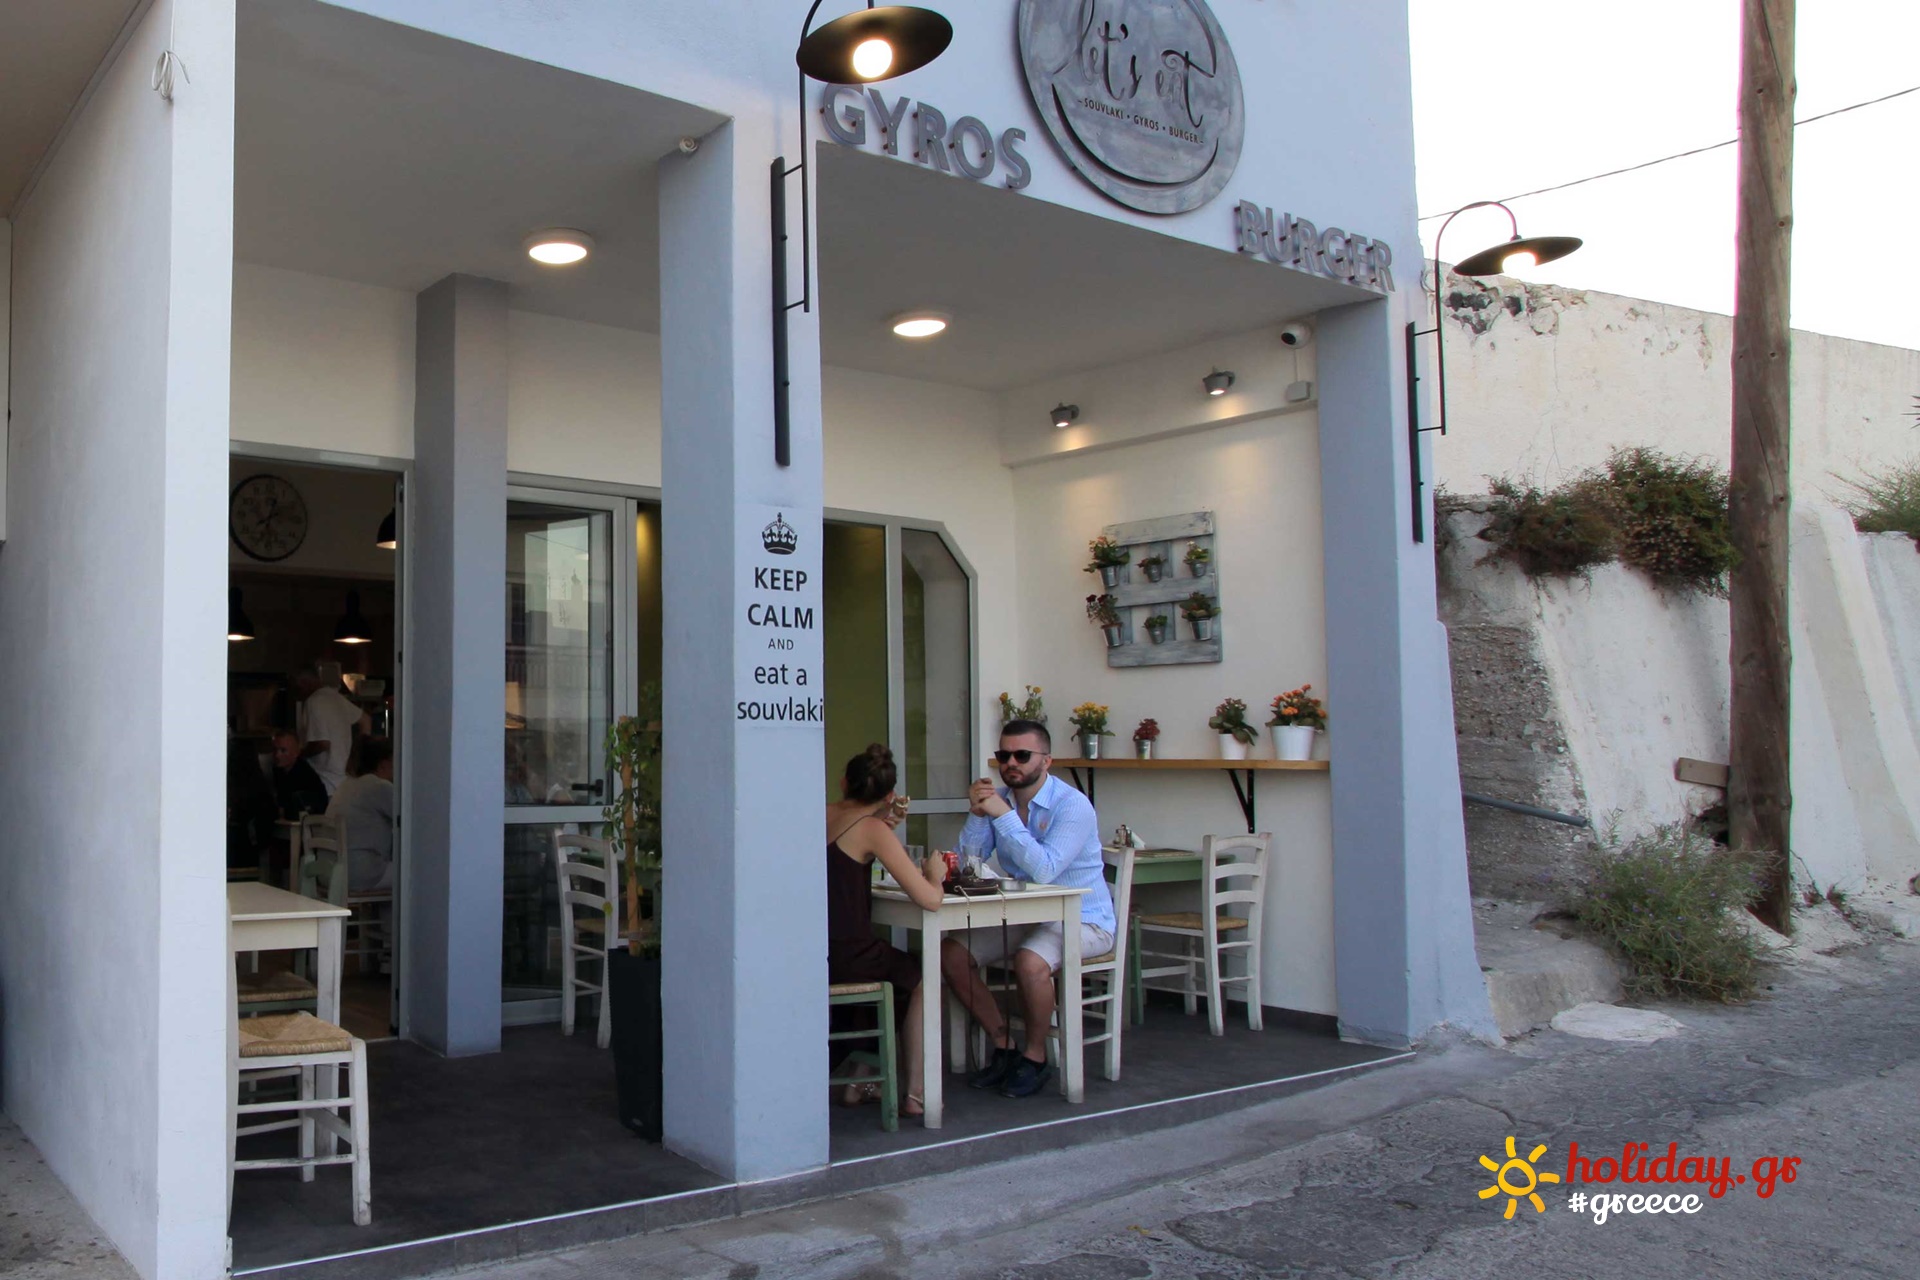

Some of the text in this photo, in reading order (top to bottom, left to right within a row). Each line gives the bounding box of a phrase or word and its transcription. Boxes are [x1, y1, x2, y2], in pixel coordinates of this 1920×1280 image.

[1084, 98, 1199, 143] SOUVLAKI GYROS BURGER
[822, 82, 1032, 190] GYROS
[1239, 199, 1396, 292] BURGER
[754, 567, 808, 592] KEEP
[747, 603, 813, 629] CALM
[768, 638, 794, 650] AND
[754, 664, 807, 686] eat a
[737, 697, 823, 722] souvlaki
